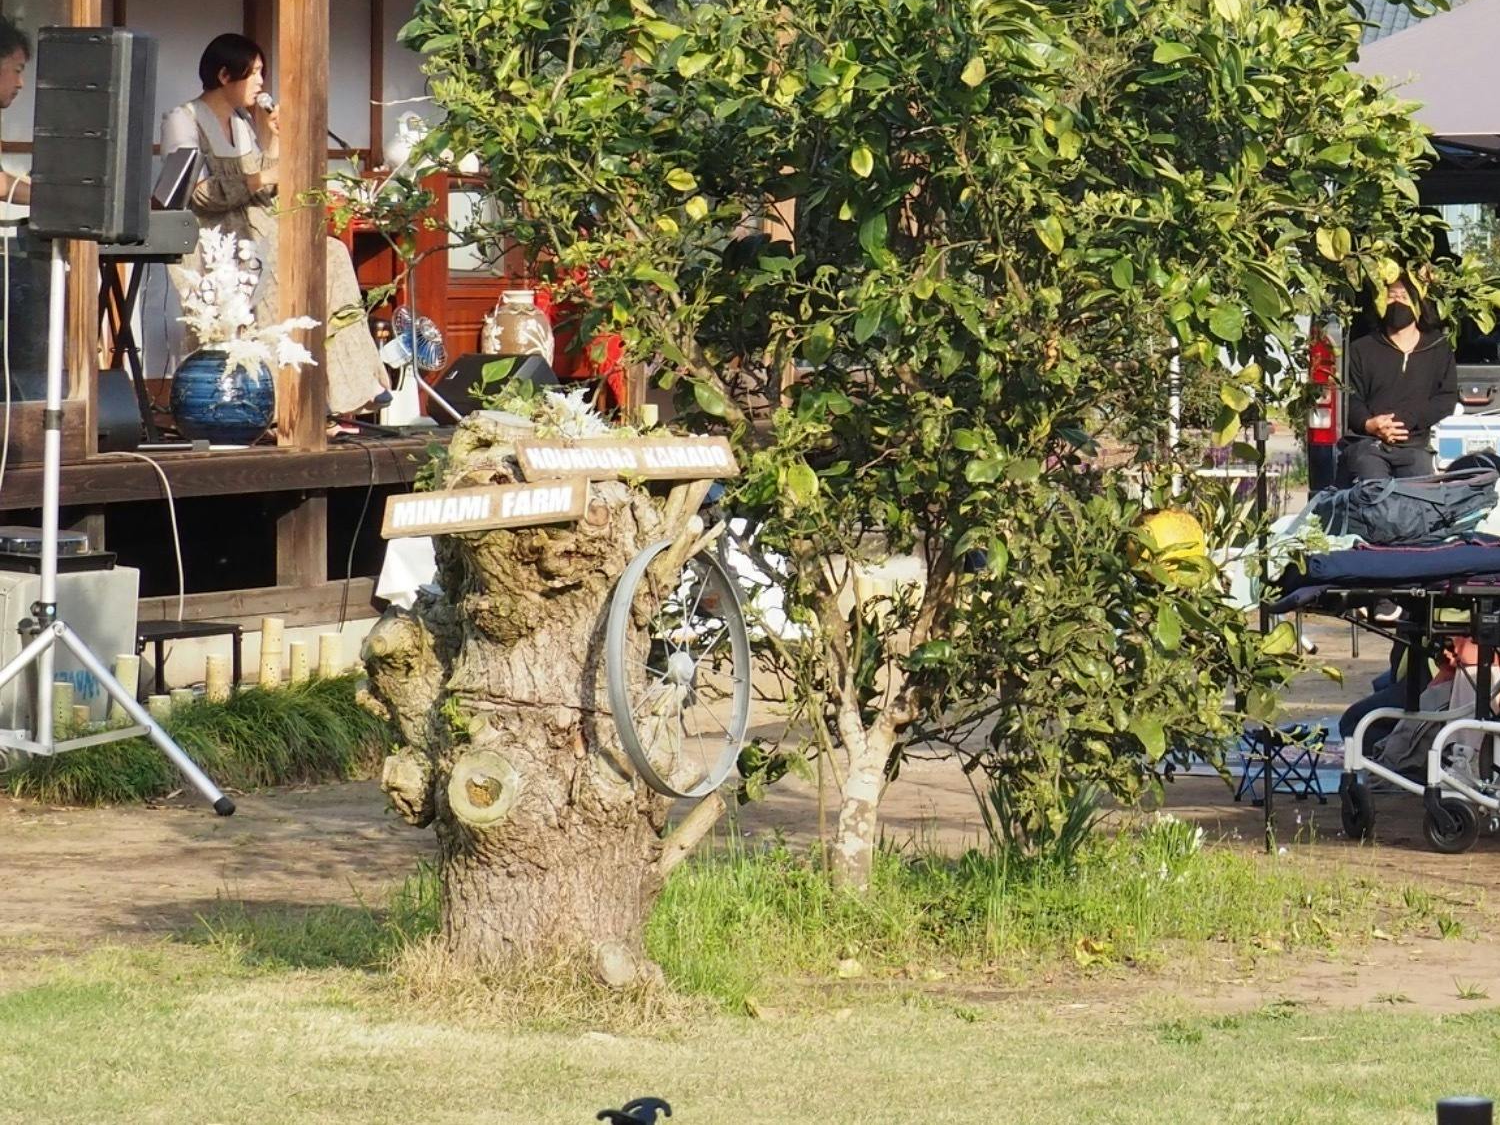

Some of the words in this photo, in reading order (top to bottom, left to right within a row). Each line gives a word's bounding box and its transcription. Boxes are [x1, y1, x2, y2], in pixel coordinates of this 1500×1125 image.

[642, 445, 729, 468] KAMADO
[392, 495, 491, 528] MINAMI
[501, 487, 573, 518] FARM
